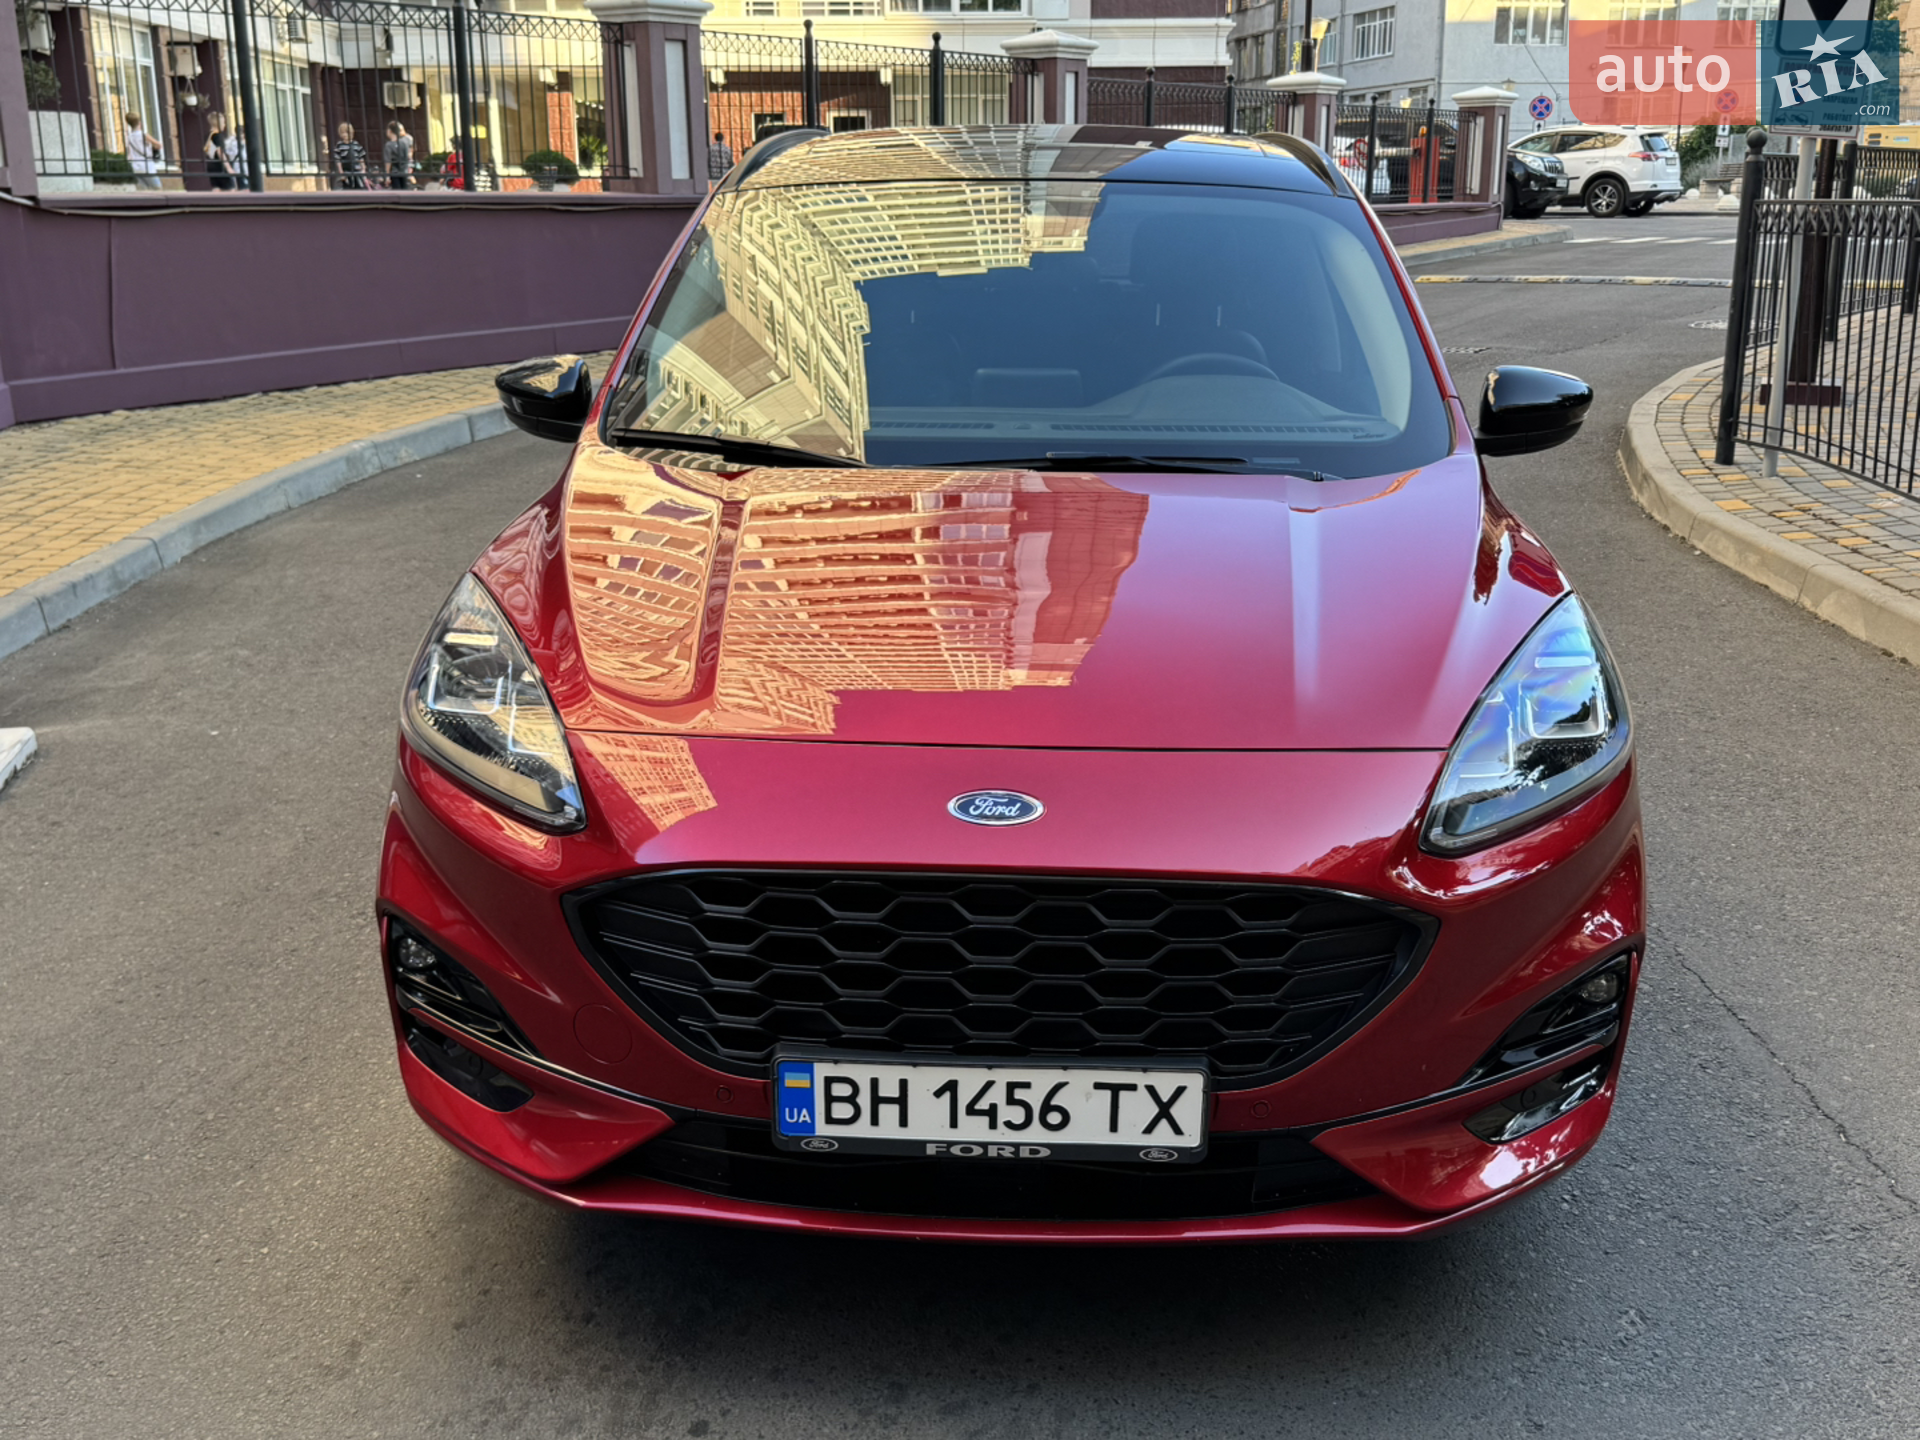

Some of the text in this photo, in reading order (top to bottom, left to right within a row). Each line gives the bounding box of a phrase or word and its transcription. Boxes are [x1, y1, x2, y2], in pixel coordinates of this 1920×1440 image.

[969, 797, 1021, 817] Ford
[824, 1076, 1188, 1135] BH 1456 TX
[785, 1107, 811, 1123] UA
[926, 1143, 1051, 1158] FORD
